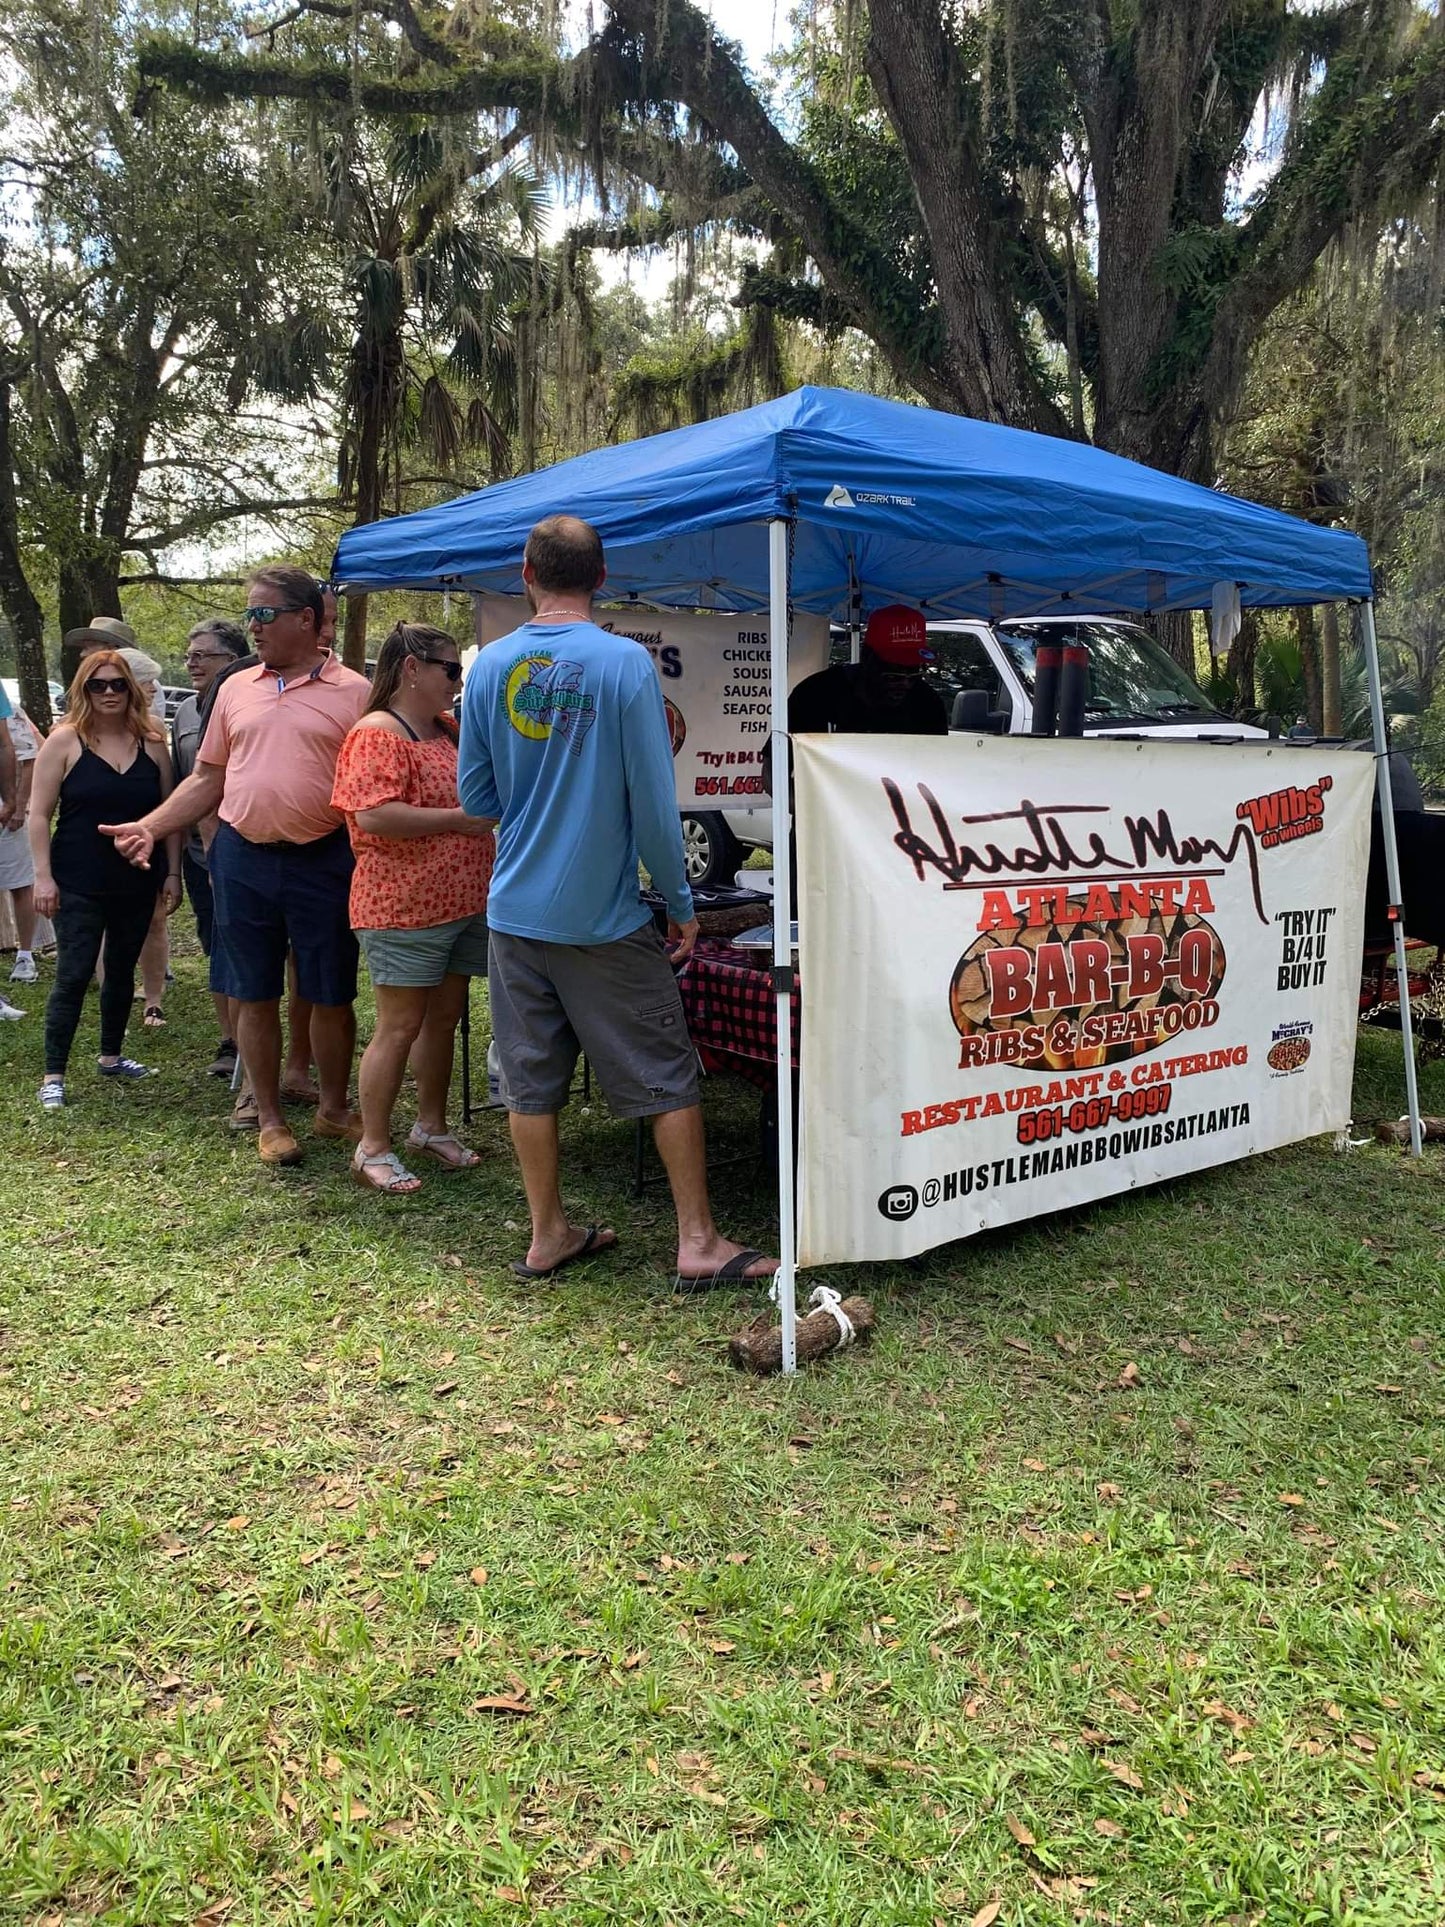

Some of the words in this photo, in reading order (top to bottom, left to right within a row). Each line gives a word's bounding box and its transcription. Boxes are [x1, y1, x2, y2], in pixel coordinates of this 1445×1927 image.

[737, 631, 768, 644] RIBS
[528, 649, 553, 658] TEAM
[723, 649, 771, 662] CHICKE
[723, 685, 771, 697] SAUSA
[723, 703, 772, 715] SEAFOO
[740, 721, 768, 733] FISH
[737, 751, 755, 764] B4
[695, 776, 765, 795] 561.667
[1236, 775, 1333, 836] "Wibs"
[881, 776, 1136, 882] Hustle
[1262, 832, 1279, 849] on
[1279, 817, 1323, 844] wheels
[977, 878, 1216, 932] ATLANTA
[1283, 937, 1313, 964] B/4
[1316, 935, 1326, 960] U
[985, 928, 1214, 1020] BAR-B-Q
[1277, 963, 1314, 991] BUY
[1313, 961, 1327, 986] IT
[957, 1025, 1046, 1070] RIBS
[1049, 1021, 1077, 1055] &
[1081, 999, 1221, 1050] SEAFOOD
[900, 1071, 1104, 1137] RESTAURANT
[1107, 1069, 1127, 1092] &
[1130, 1045, 1249, 1086] CATERING
[1016, 1083, 1173, 1146] 561-667-9997
[921, 1102, 1251, 1208] @HUSTLEMANBBQWIBSATLANTA
